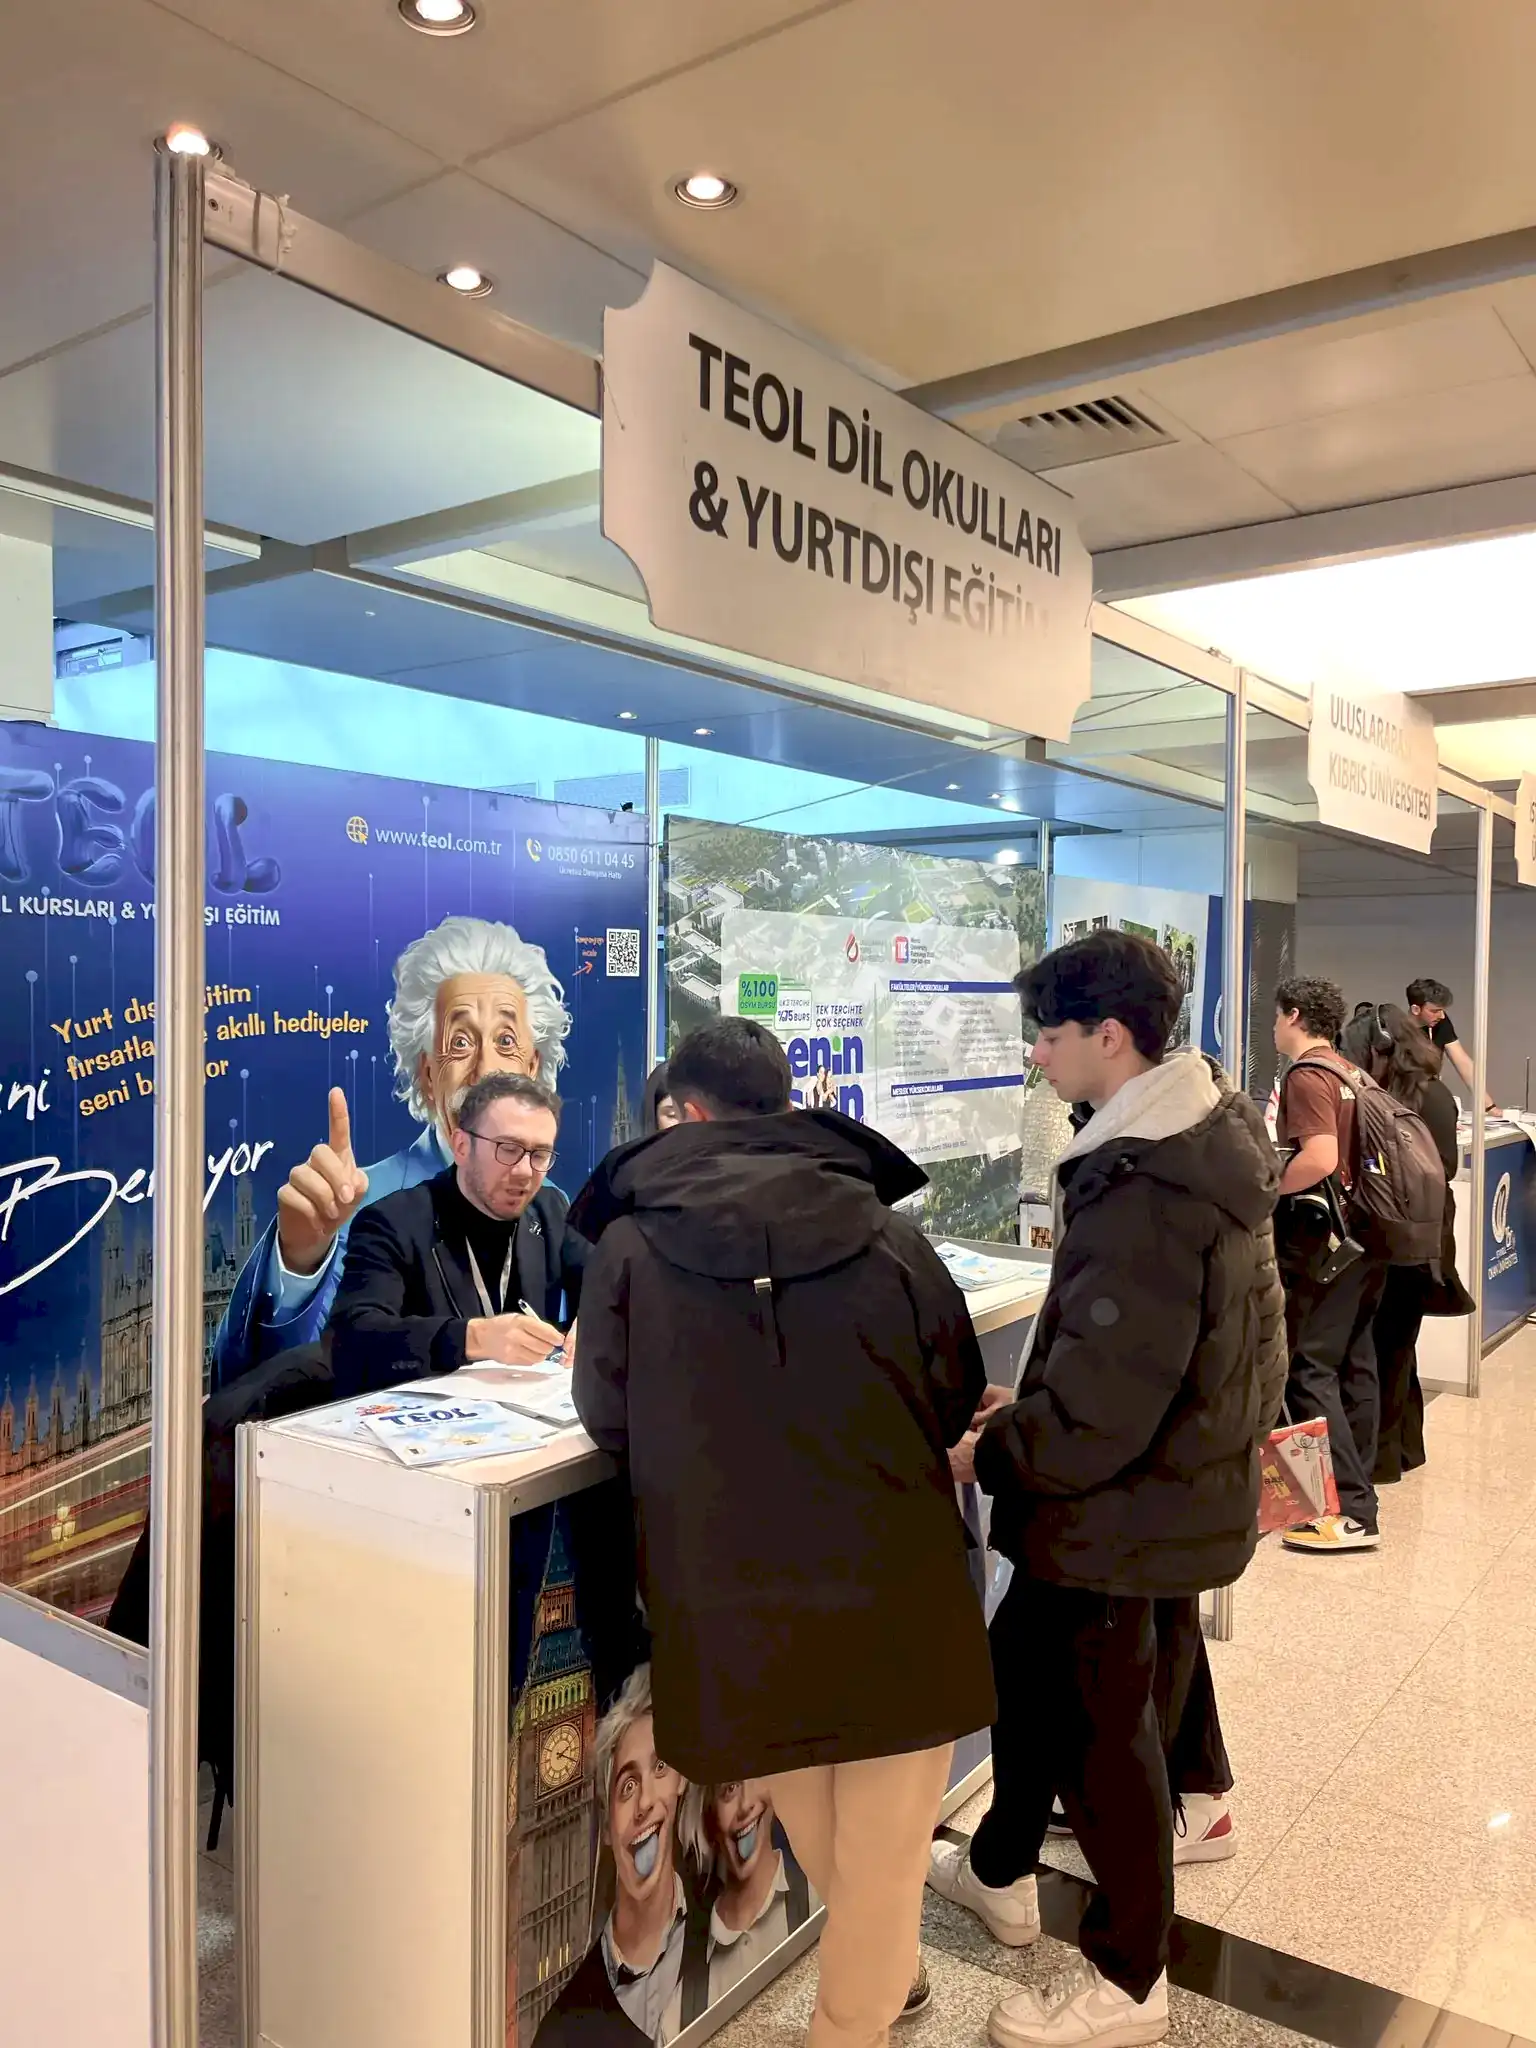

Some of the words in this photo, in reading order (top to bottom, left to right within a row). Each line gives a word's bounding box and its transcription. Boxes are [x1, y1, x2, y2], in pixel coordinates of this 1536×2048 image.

[689, 332, 816, 461] TEOL
[828, 408, 893, 497] DİL
[903, 449, 1061, 577] OKULLARI
[689, 460, 729, 540] &
[736, 475, 934, 626] YURTDIŞI
[1329, 750, 1367, 797] KIBRIS
[375, 828, 502, 856] www.teol.com.tr
[548, 846, 578, 863] 0850
[580, 848, 601, 866] 611
[604, 851, 619, 869] 04
[621, 852, 635, 869] 45
[19, 896, 115, 919] KURSLARI
[121, 902, 136, 919] &
[225, 903, 281, 926] EĞİTİM
[741, 980, 776, 997] %100
[794, 1013, 810, 1022] BURS
[816, 1005, 829, 1015] TEK
[830, 1004, 863, 1015] TERCİHTE
[50, 1007, 113, 1043] Yurt
[216, 1012, 266, 1041] akıllı
[273, 1010, 369, 1039] hediyeler
[816, 1019, 831, 1030] ÇOK
[833, 1017, 863, 1030] SEÇENEK
[79, 1080, 130, 1116] seni
[379, 1407, 479, 1426] TEOL
